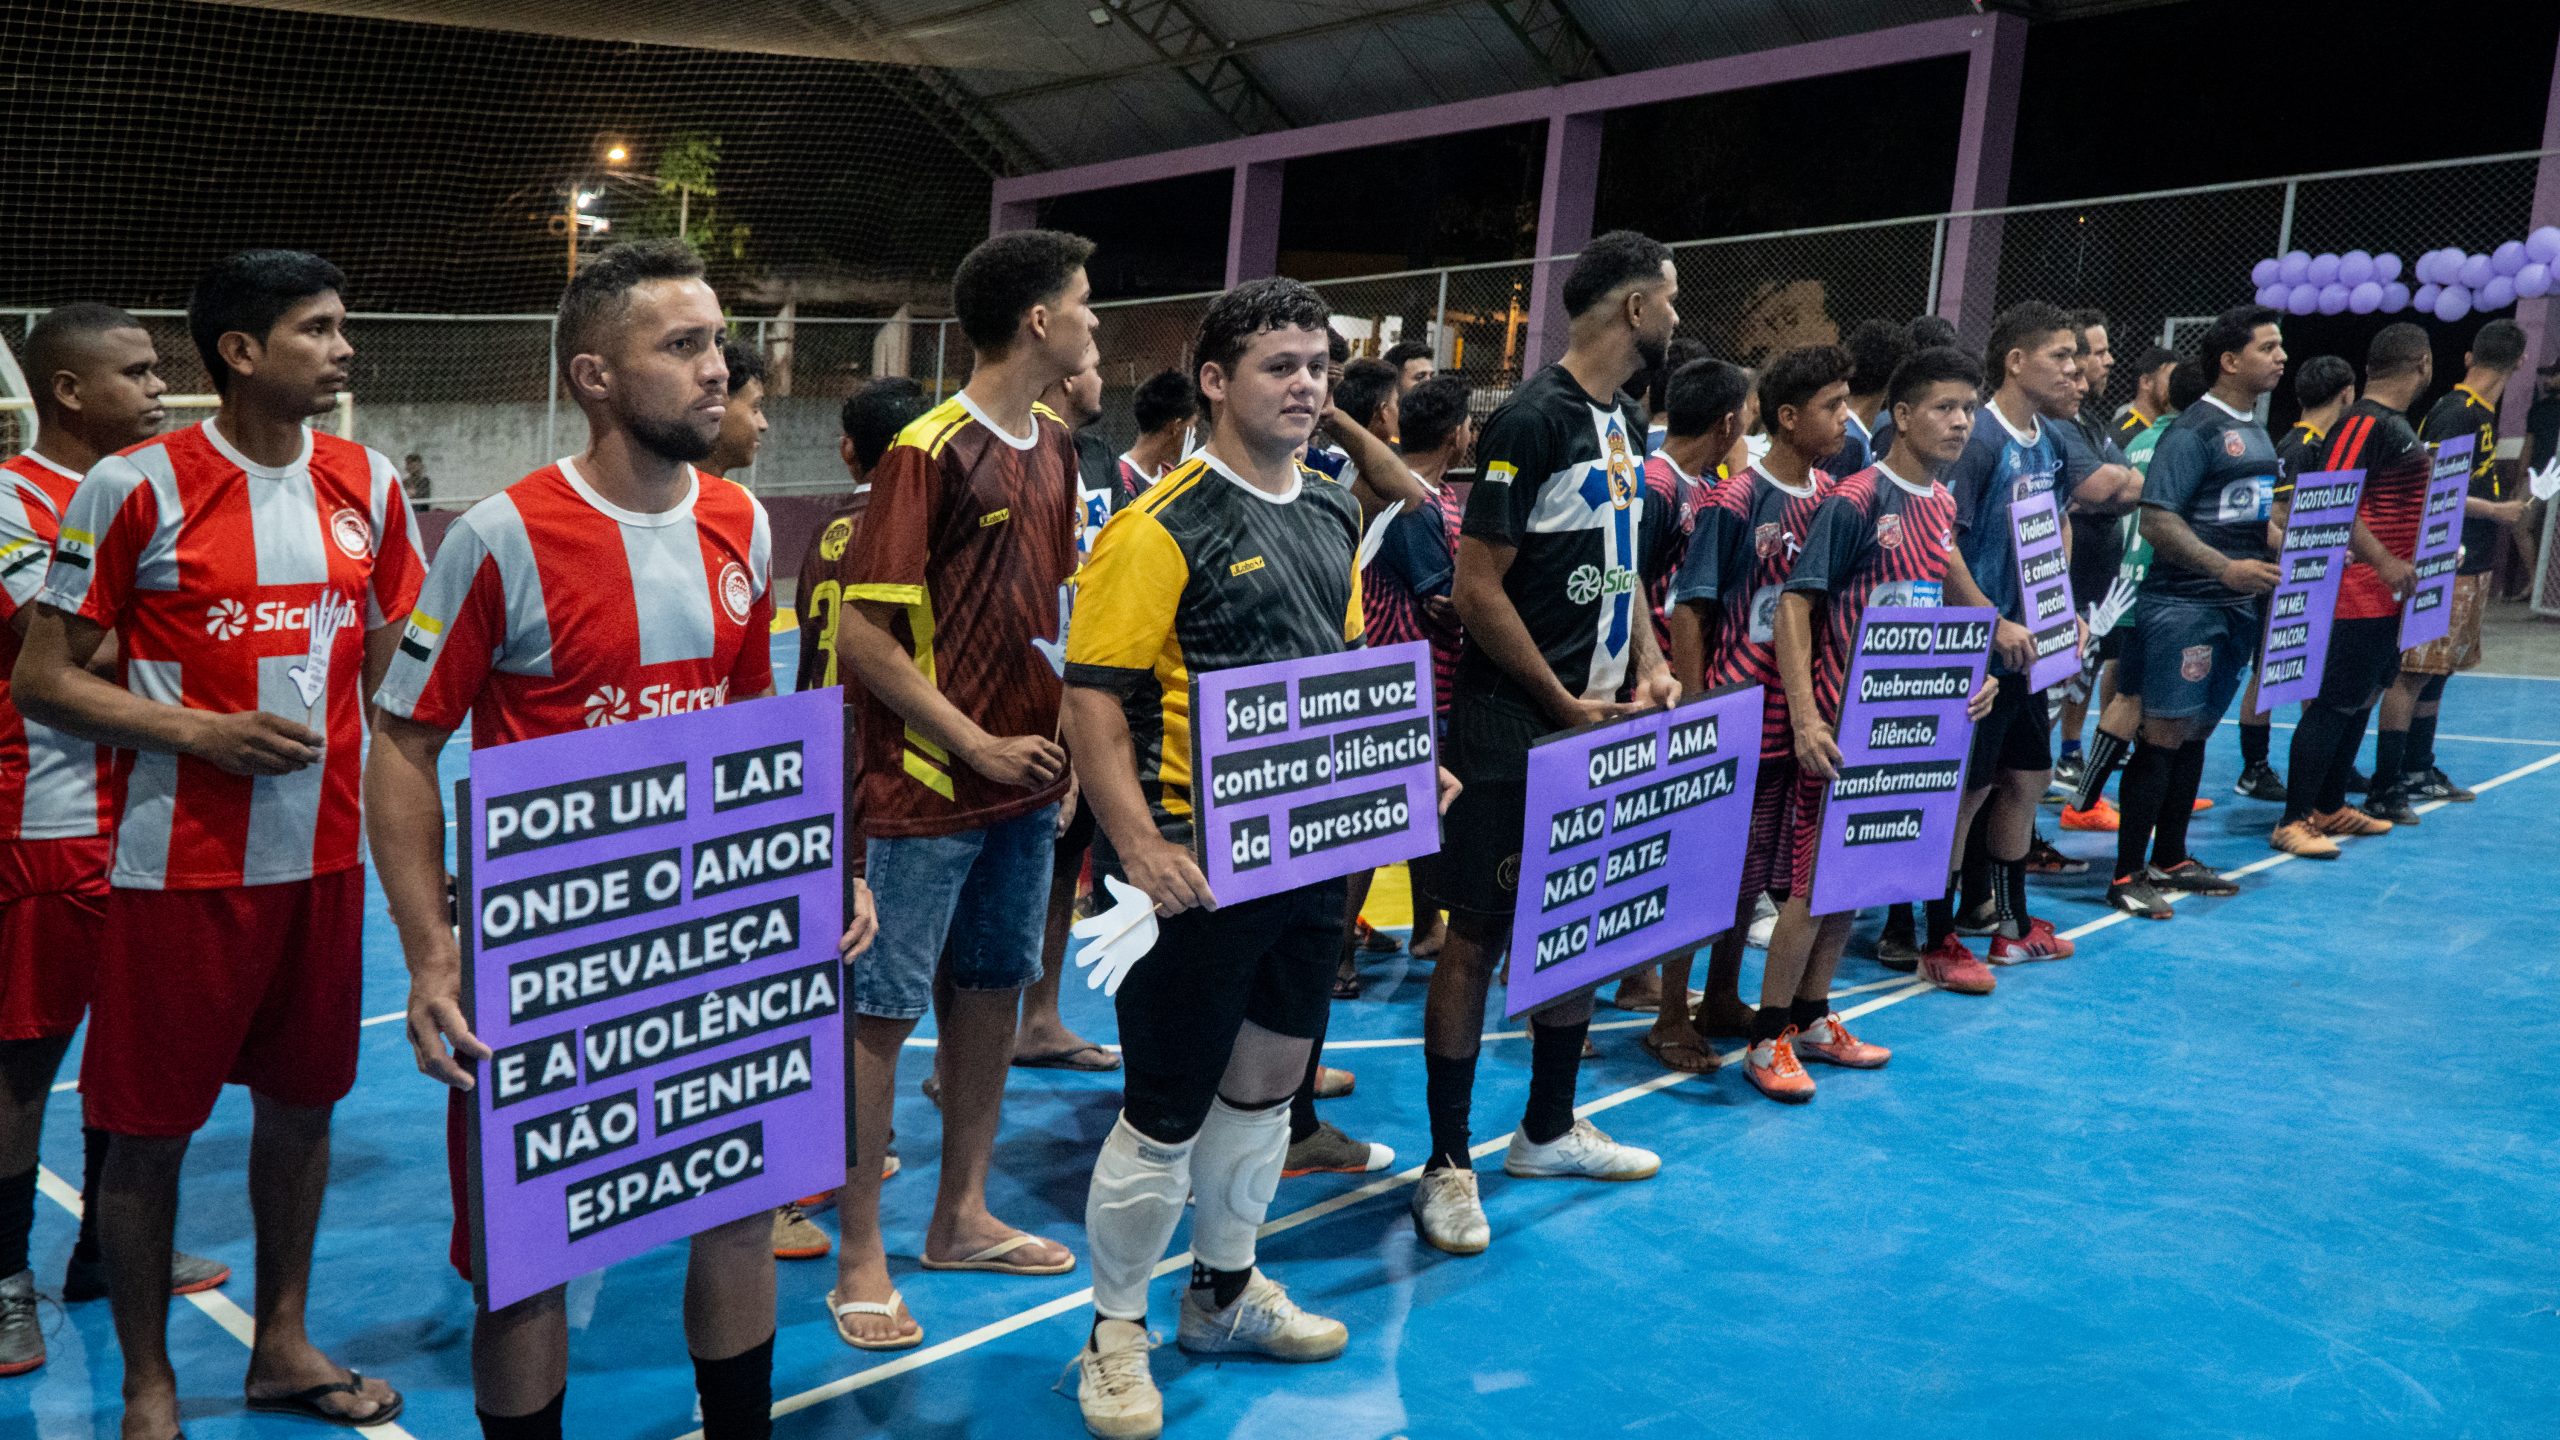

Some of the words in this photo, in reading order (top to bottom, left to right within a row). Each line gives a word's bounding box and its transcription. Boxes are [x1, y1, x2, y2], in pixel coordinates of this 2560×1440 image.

[2294, 487, 2330, 511] AGOSTO
[2019, 516, 2055, 542] Violência
[2024, 561, 2031, 583] é
[2032, 560, 2056, 582] crime
[2296, 560, 2327, 580] mulher
[2037, 590, 2066, 620] preciso
[1862, 627, 1932, 650] AGOSTO
[1935, 623, 1987, 649] LILÁS:
[2034, 622, 2077, 656] enunciar!
[1227, 695, 1287, 733] Seja
[1300, 689, 1360, 719] uma
[1369, 681, 1416, 705] voz
[1861, 674, 1955, 700] Quebrando
[1959, 678, 1969, 693] o
[1589, 740, 1656, 785] QUEM
[1668, 723, 1717, 759] AMA
[1871, 723, 1936, 745] silêncio,
[1213, 759, 1307, 800] contra
[1316, 755, 1332, 778] o
[1334, 728, 1432, 774] silêncio
[1834, 770, 1958, 795] transformamos
[488, 792, 594, 848] POR
[611, 774, 685, 822] UM
[715, 752, 802, 802] LAR
[1551, 808, 1604, 847] NÃO
[1613, 768, 1732, 826] MALTRATA,
[1845, 826, 1854, 841] o
[1859, 815, 1920, 840] mundo.
[1232, 828, 1270, 863] da
[1290, 798, 1408, 852] opressão
[483, 870, 629, 937] ONDE
[645, 861, 680, 900] O
[693, 826, 830, 889] AMOR
[1544, 866, 1596, 906] NÃO
[1606, 840, 1667, 881] BATE,
[1536, 925, 1588, 966] NÃO
[1597, 896, 1664, 940] MATA.
[510, 909, 791, 1013] PREVALEÇA
[499, 1058, 525, 1097] E
[542, 1043, 576, 1084] A
[586, 972, 835, 1072] VIOLÊNCIA
[526, 1103, 636, 1168] NÃO
[655, 1052, 811, 1124] TENHA
[567, 1139, 763, 1231] ESPAÇO.
